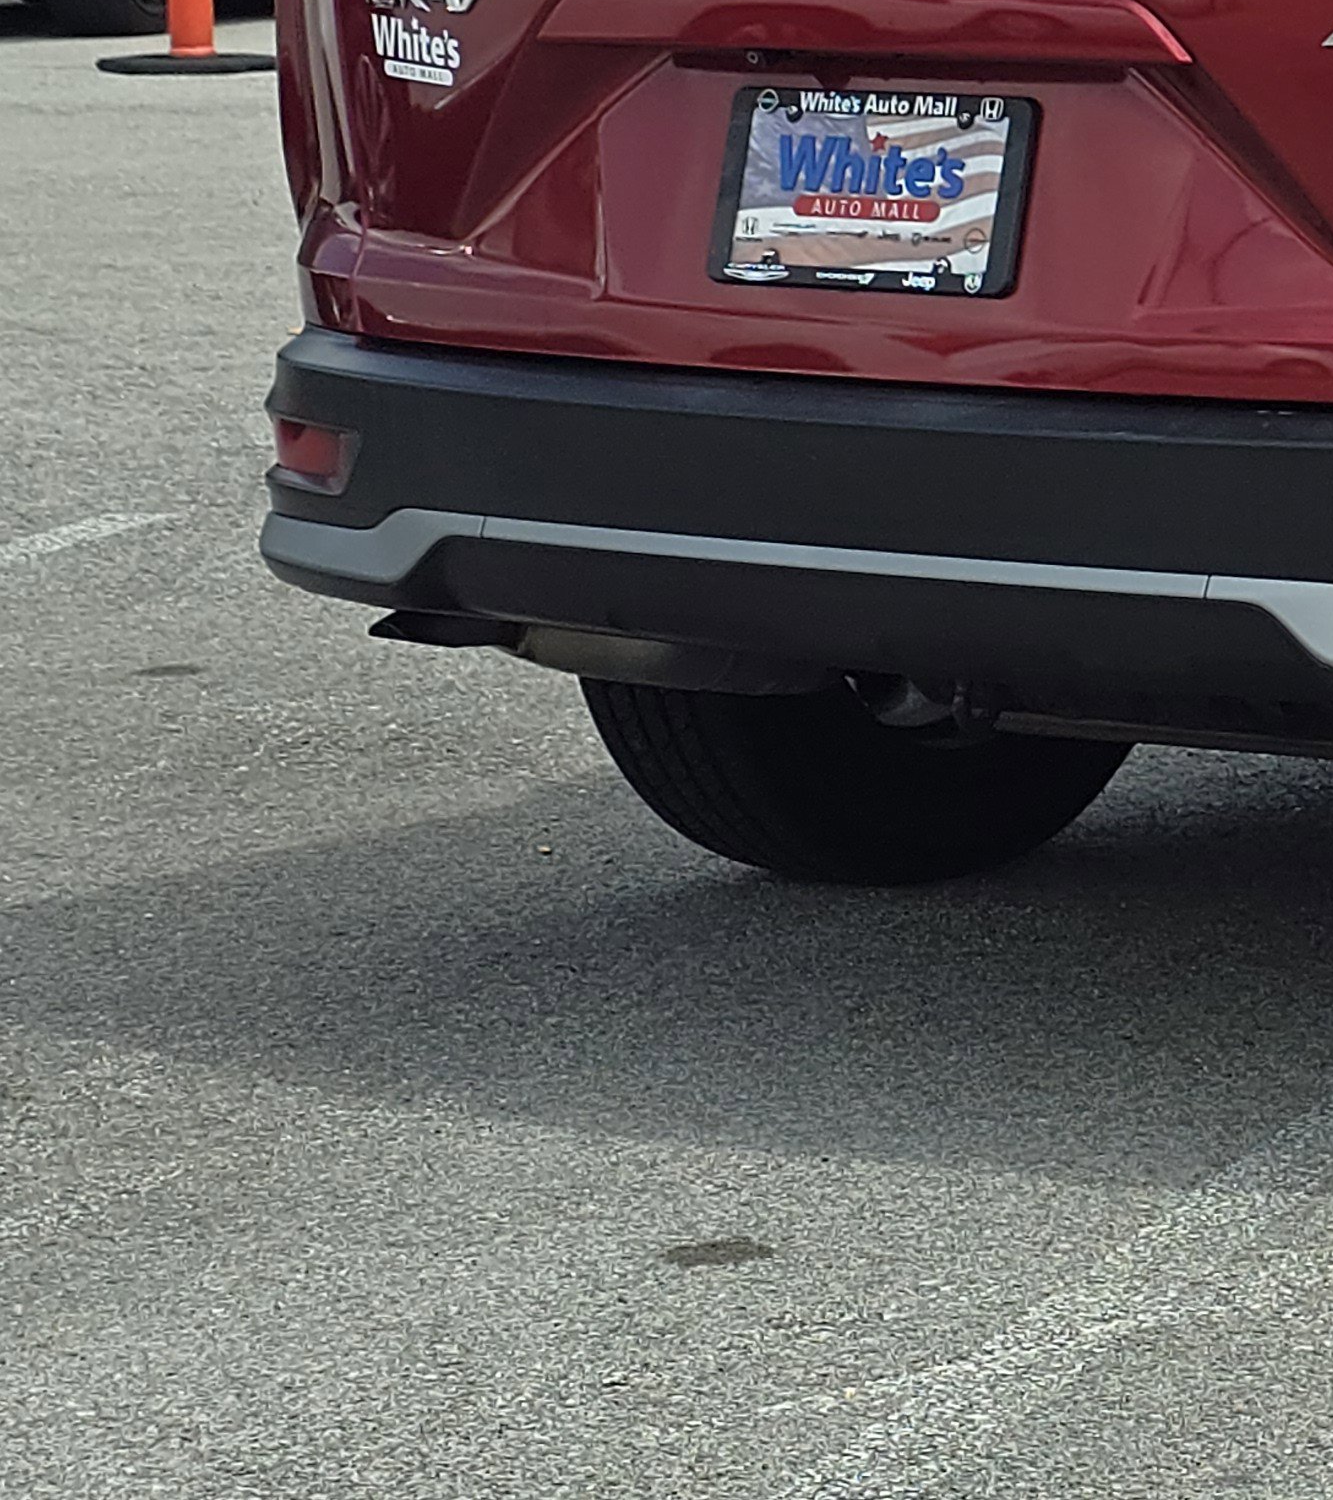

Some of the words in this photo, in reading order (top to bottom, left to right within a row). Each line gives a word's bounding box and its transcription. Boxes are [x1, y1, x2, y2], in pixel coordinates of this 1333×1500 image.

[371, 13, 461, 68] White's
[800, 91, 861, 114] White's
[863, 94, 910, 116] Auto
[912, 96, 958, 117] Mall
[779, 133, 966, 199] White's
[810, 198, 862, 217] AUTO
[871, 201, 920, 220] MALL
